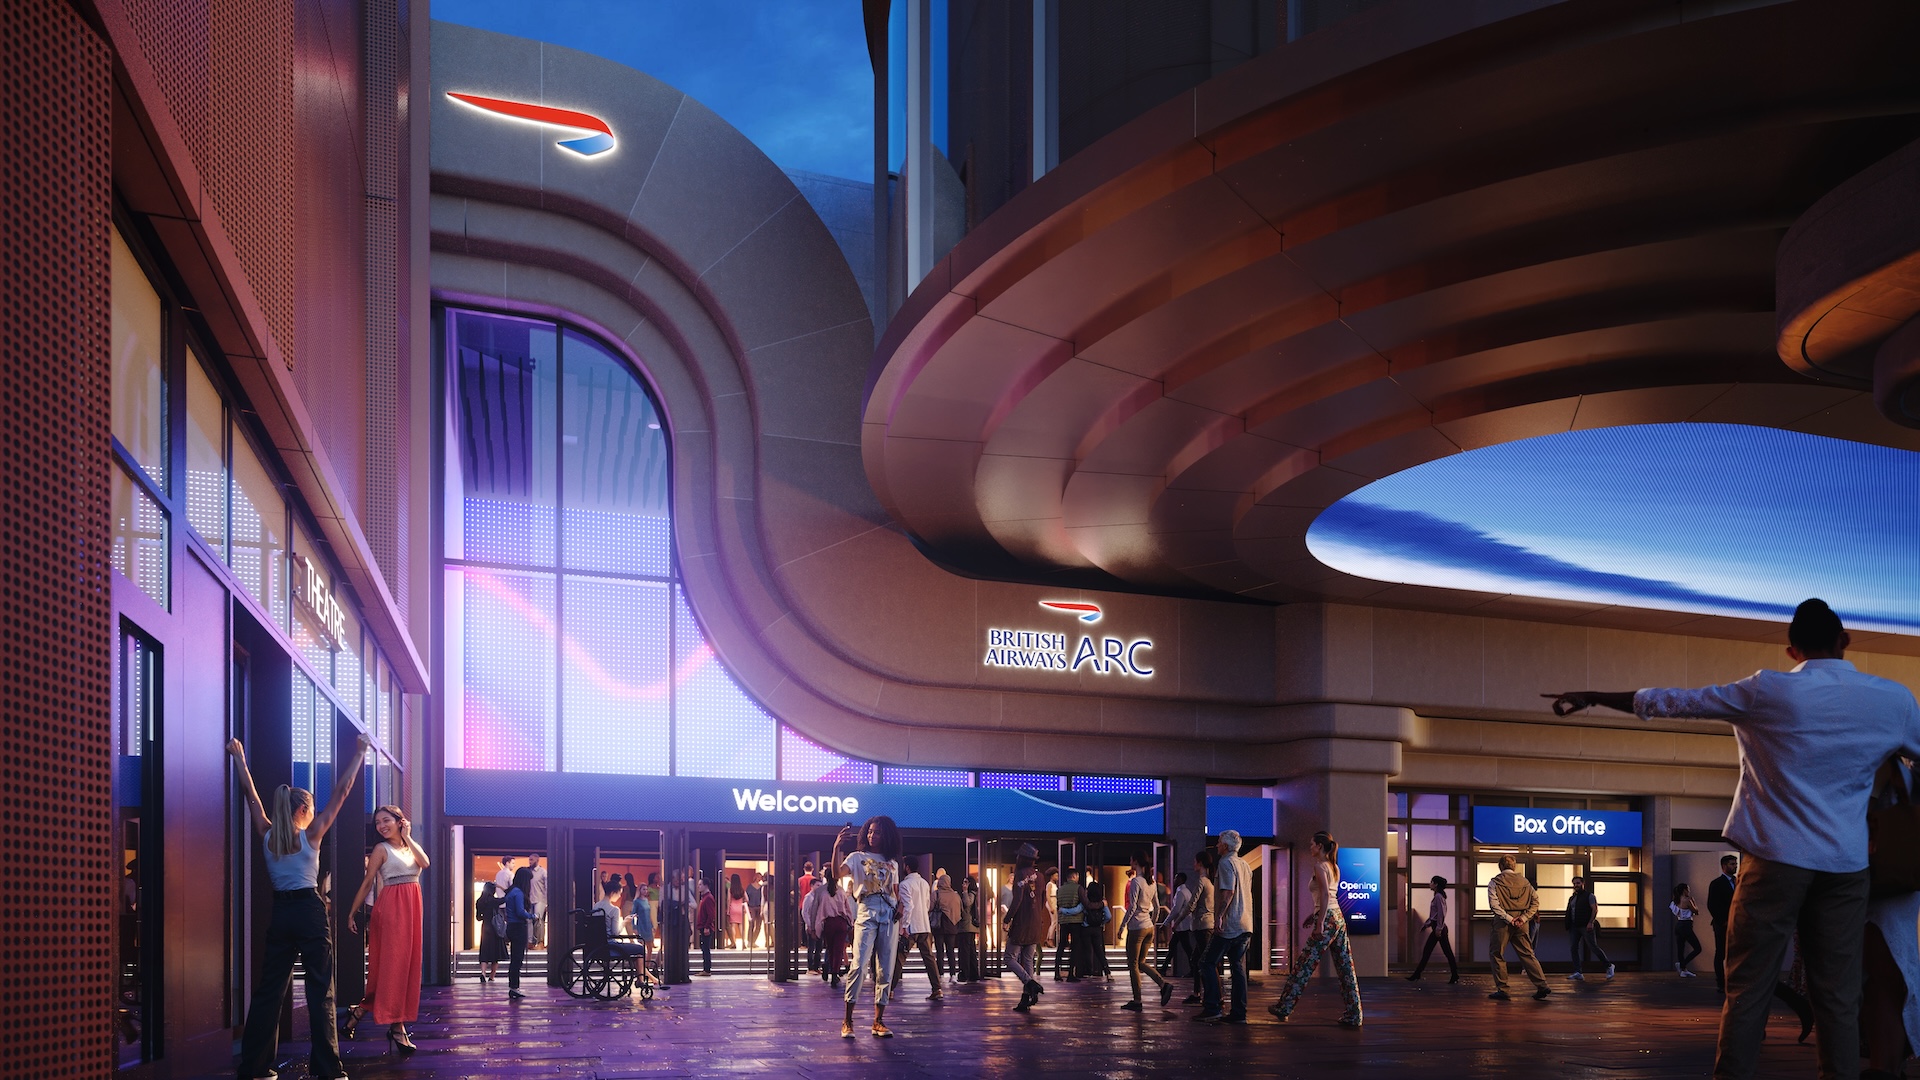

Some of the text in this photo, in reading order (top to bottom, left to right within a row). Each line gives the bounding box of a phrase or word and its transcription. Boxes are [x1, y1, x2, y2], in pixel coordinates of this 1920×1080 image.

[305, 557, 345, 651] THEATRE
[990, 629, 1065, 650] BRITISH
[985, 648, 1067, 669] AIRWAYS
[1072, 637, 1153, 676] ARC
[732, 788, 859, 814] Welcome
[1514, 814, 1606, 836] Box Office
[1340, 881, 1377, 892] Opening
